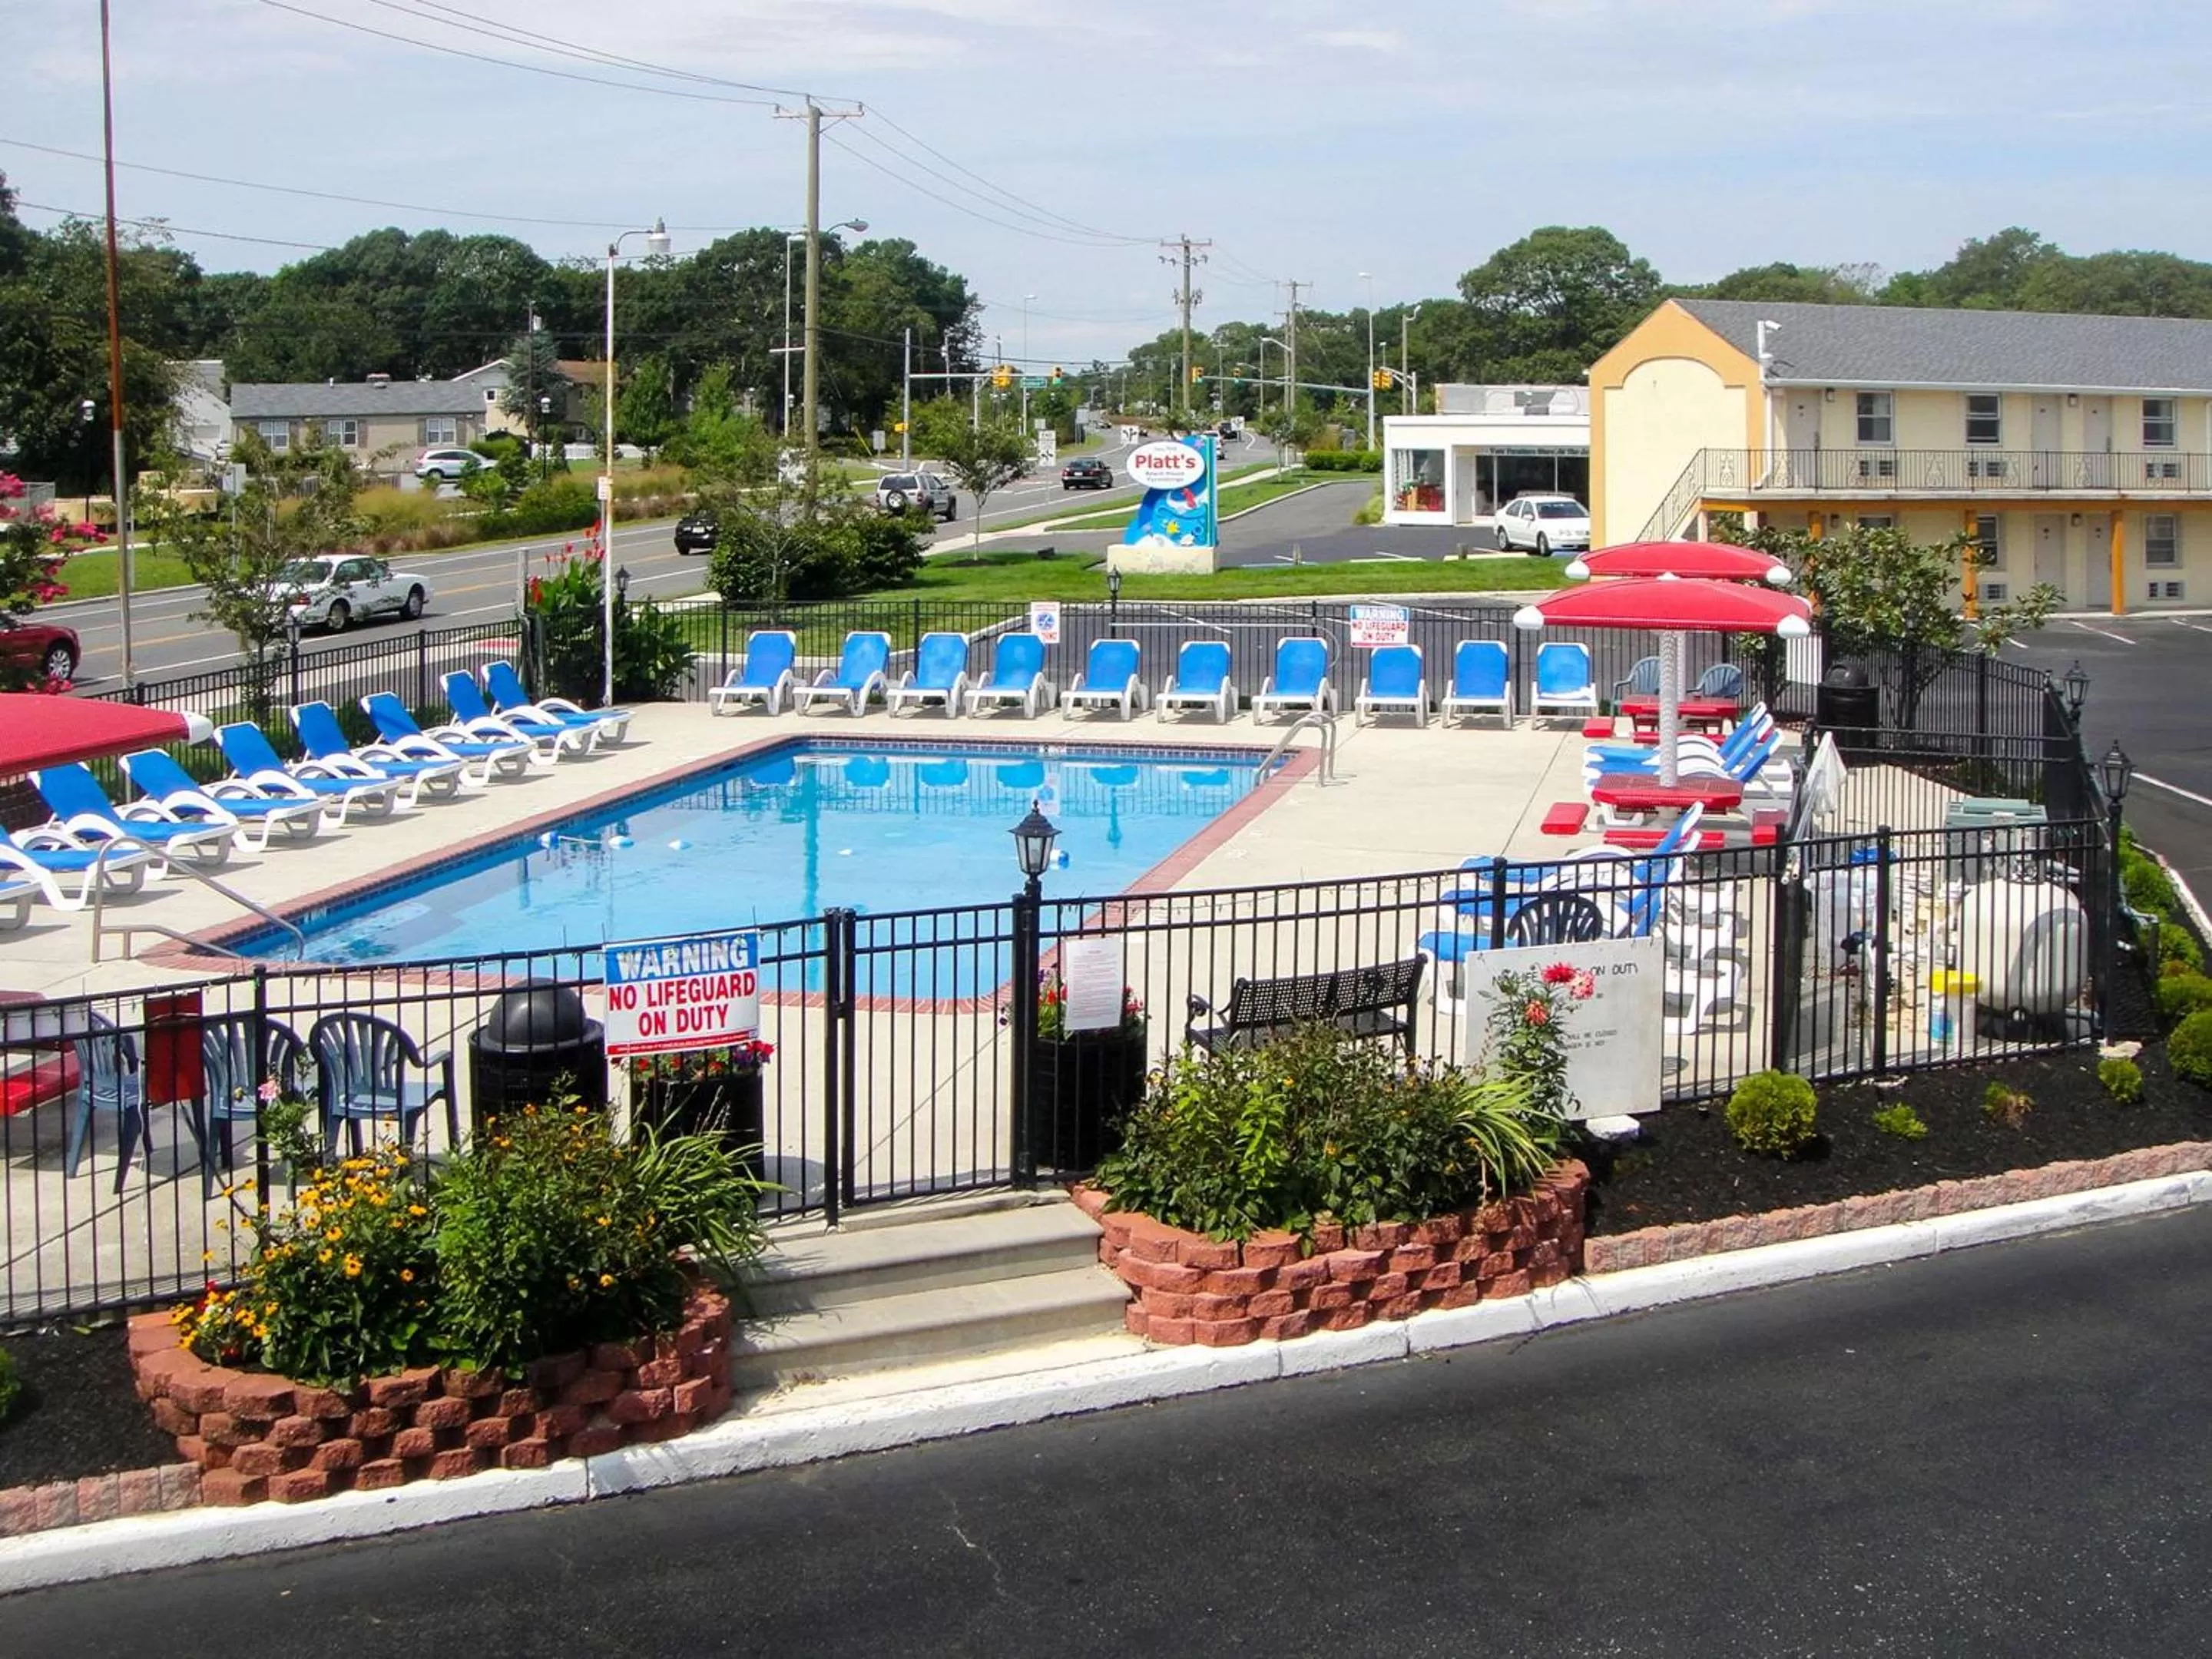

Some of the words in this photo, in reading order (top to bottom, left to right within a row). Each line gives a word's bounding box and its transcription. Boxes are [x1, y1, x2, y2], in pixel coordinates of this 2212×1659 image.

[1135, 454, 1196, 469] Platt's
[1355, 608, 1404, 621] WARNING
[1352, 621, 1363, 630] NO
[1366, 621, 1406, 631] LIFEGUARD
[1362, 631, 1373, 641] ON
[1376, 631, 1395, 641] DUTY
[617, 937, 748, 980] WARNING
[609, 985, 637, 1011] NO
[647, 972, 756, 1007] LIFEGUARD
[639, 1011, 666, 1037] ON
[677, 1004, 729, 1033] DUTY
